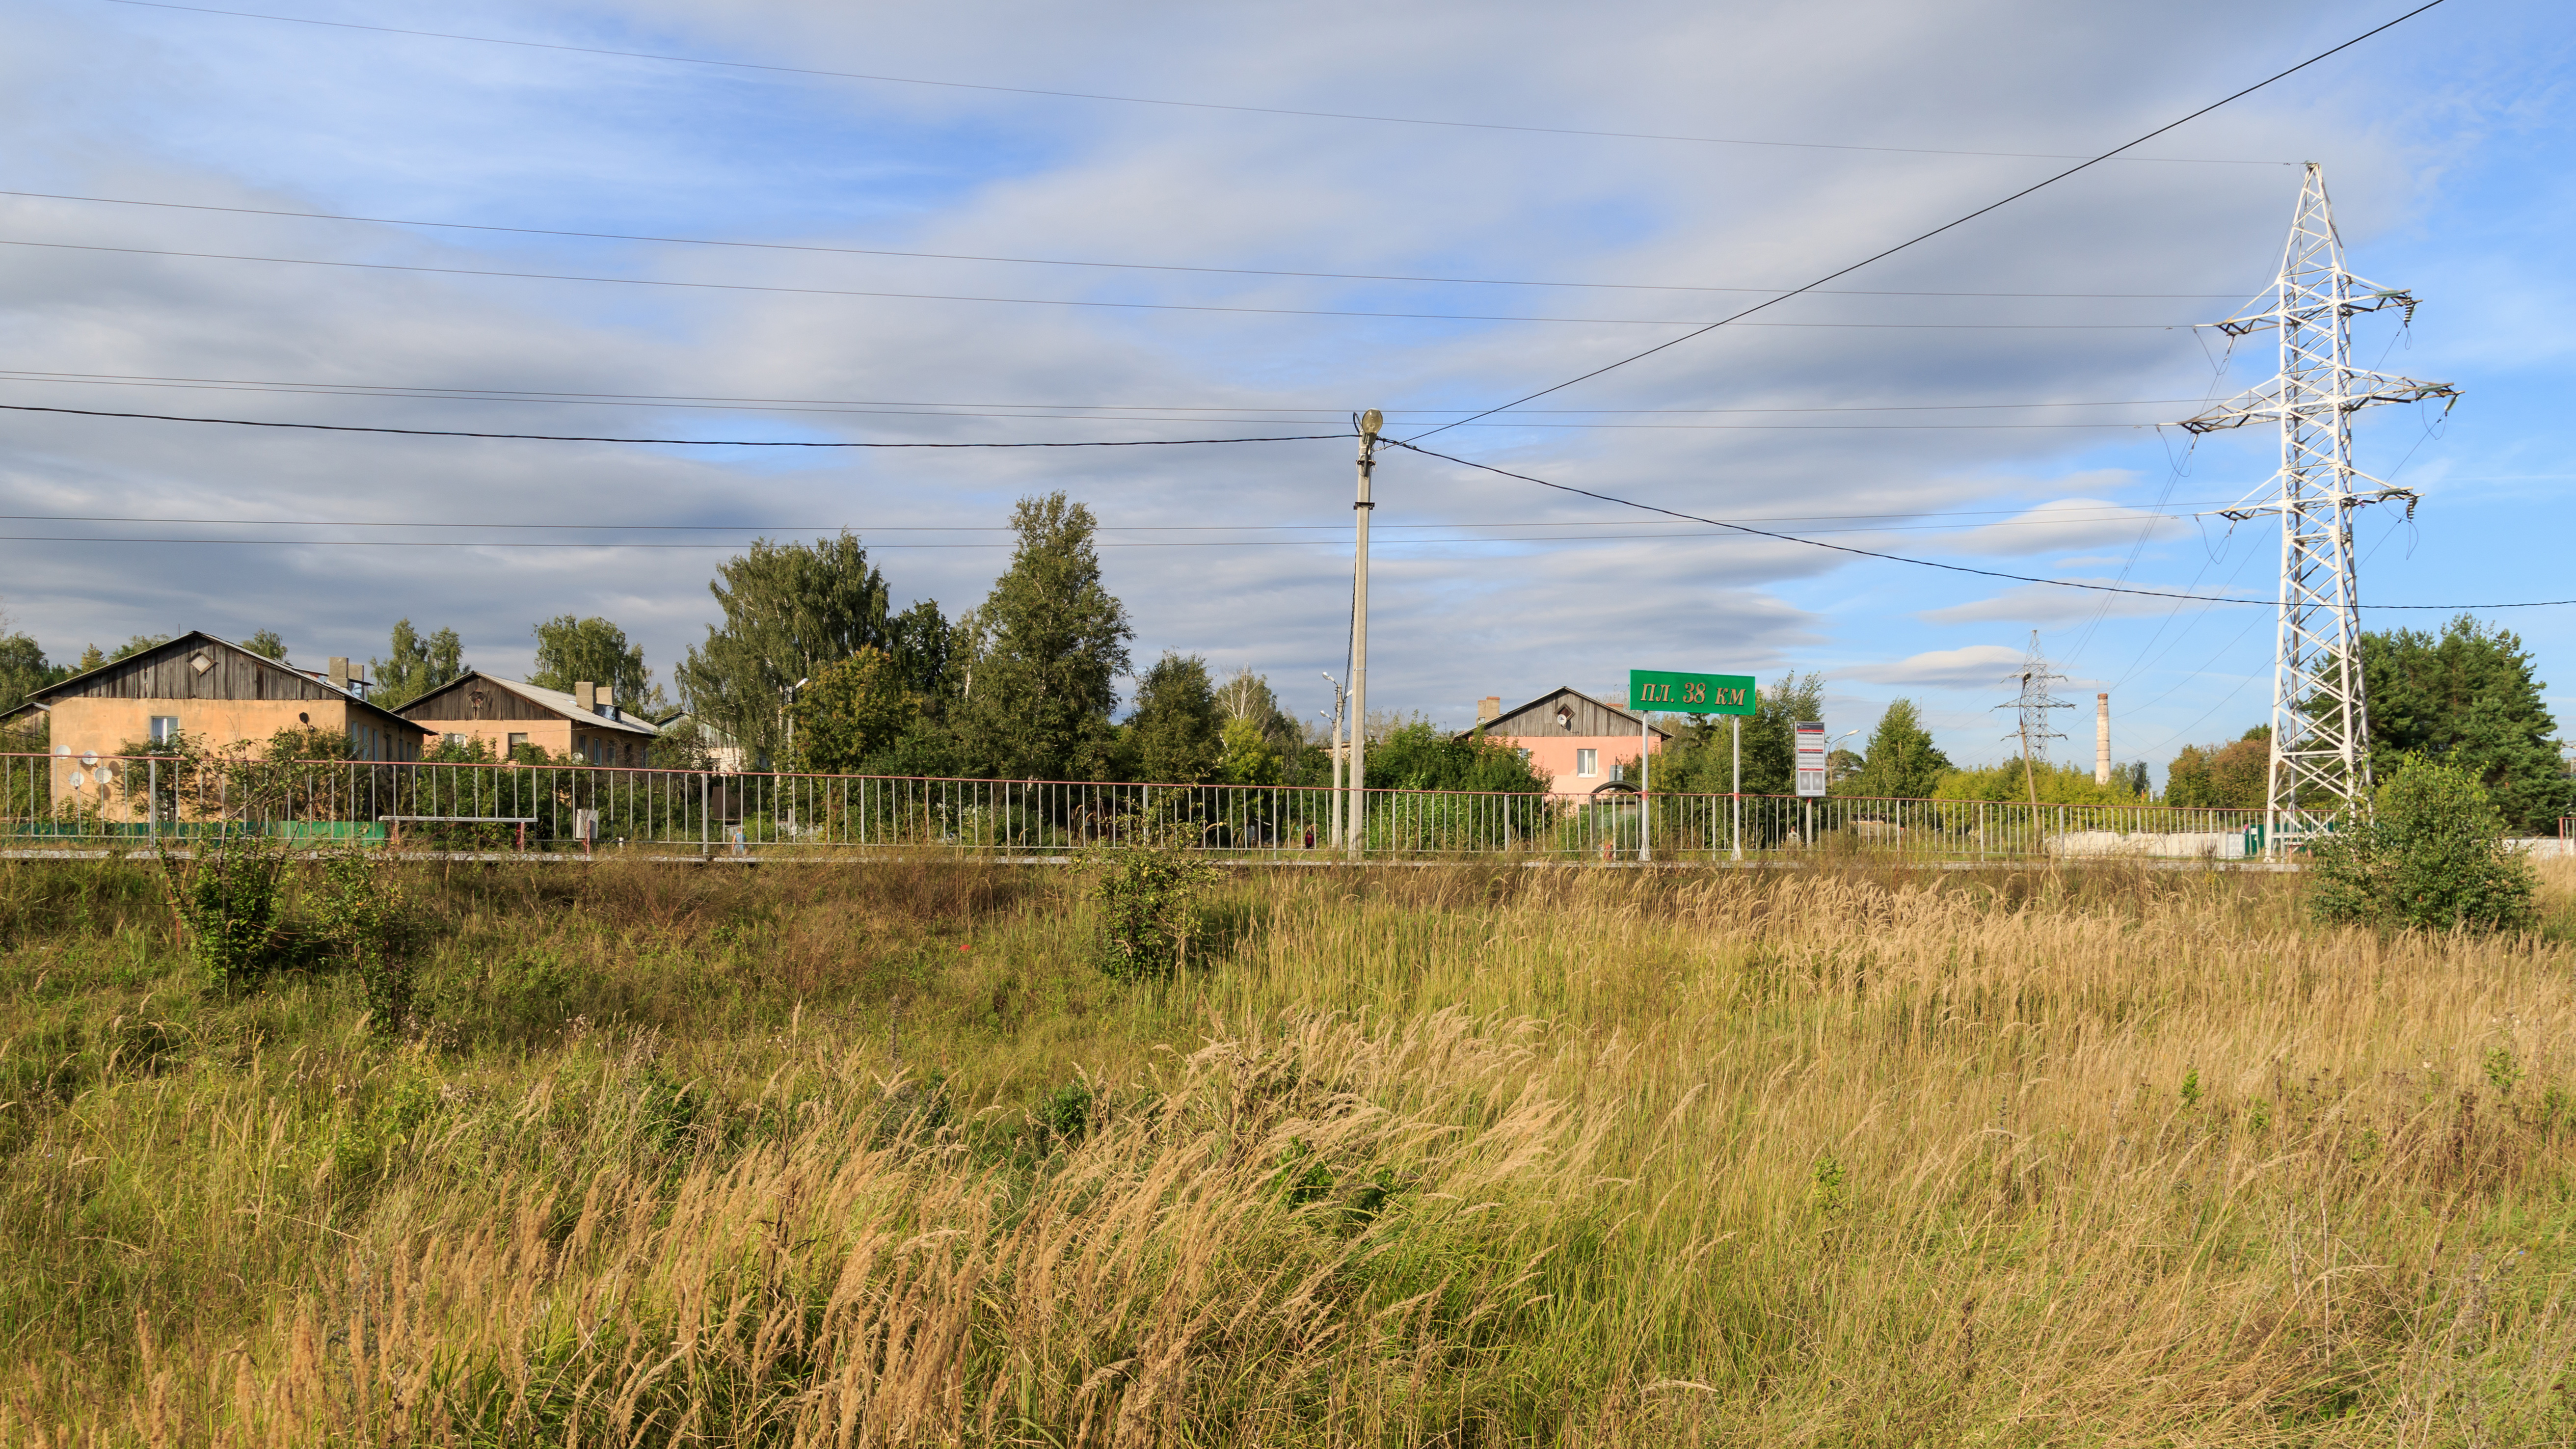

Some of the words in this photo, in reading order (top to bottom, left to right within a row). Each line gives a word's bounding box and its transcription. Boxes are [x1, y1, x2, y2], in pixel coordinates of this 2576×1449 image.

[1640, 683, 1674, 702] ПЛ.
[1683, 682, 1706, 704] 38
[1715, 688, 1746, 705] КМ
